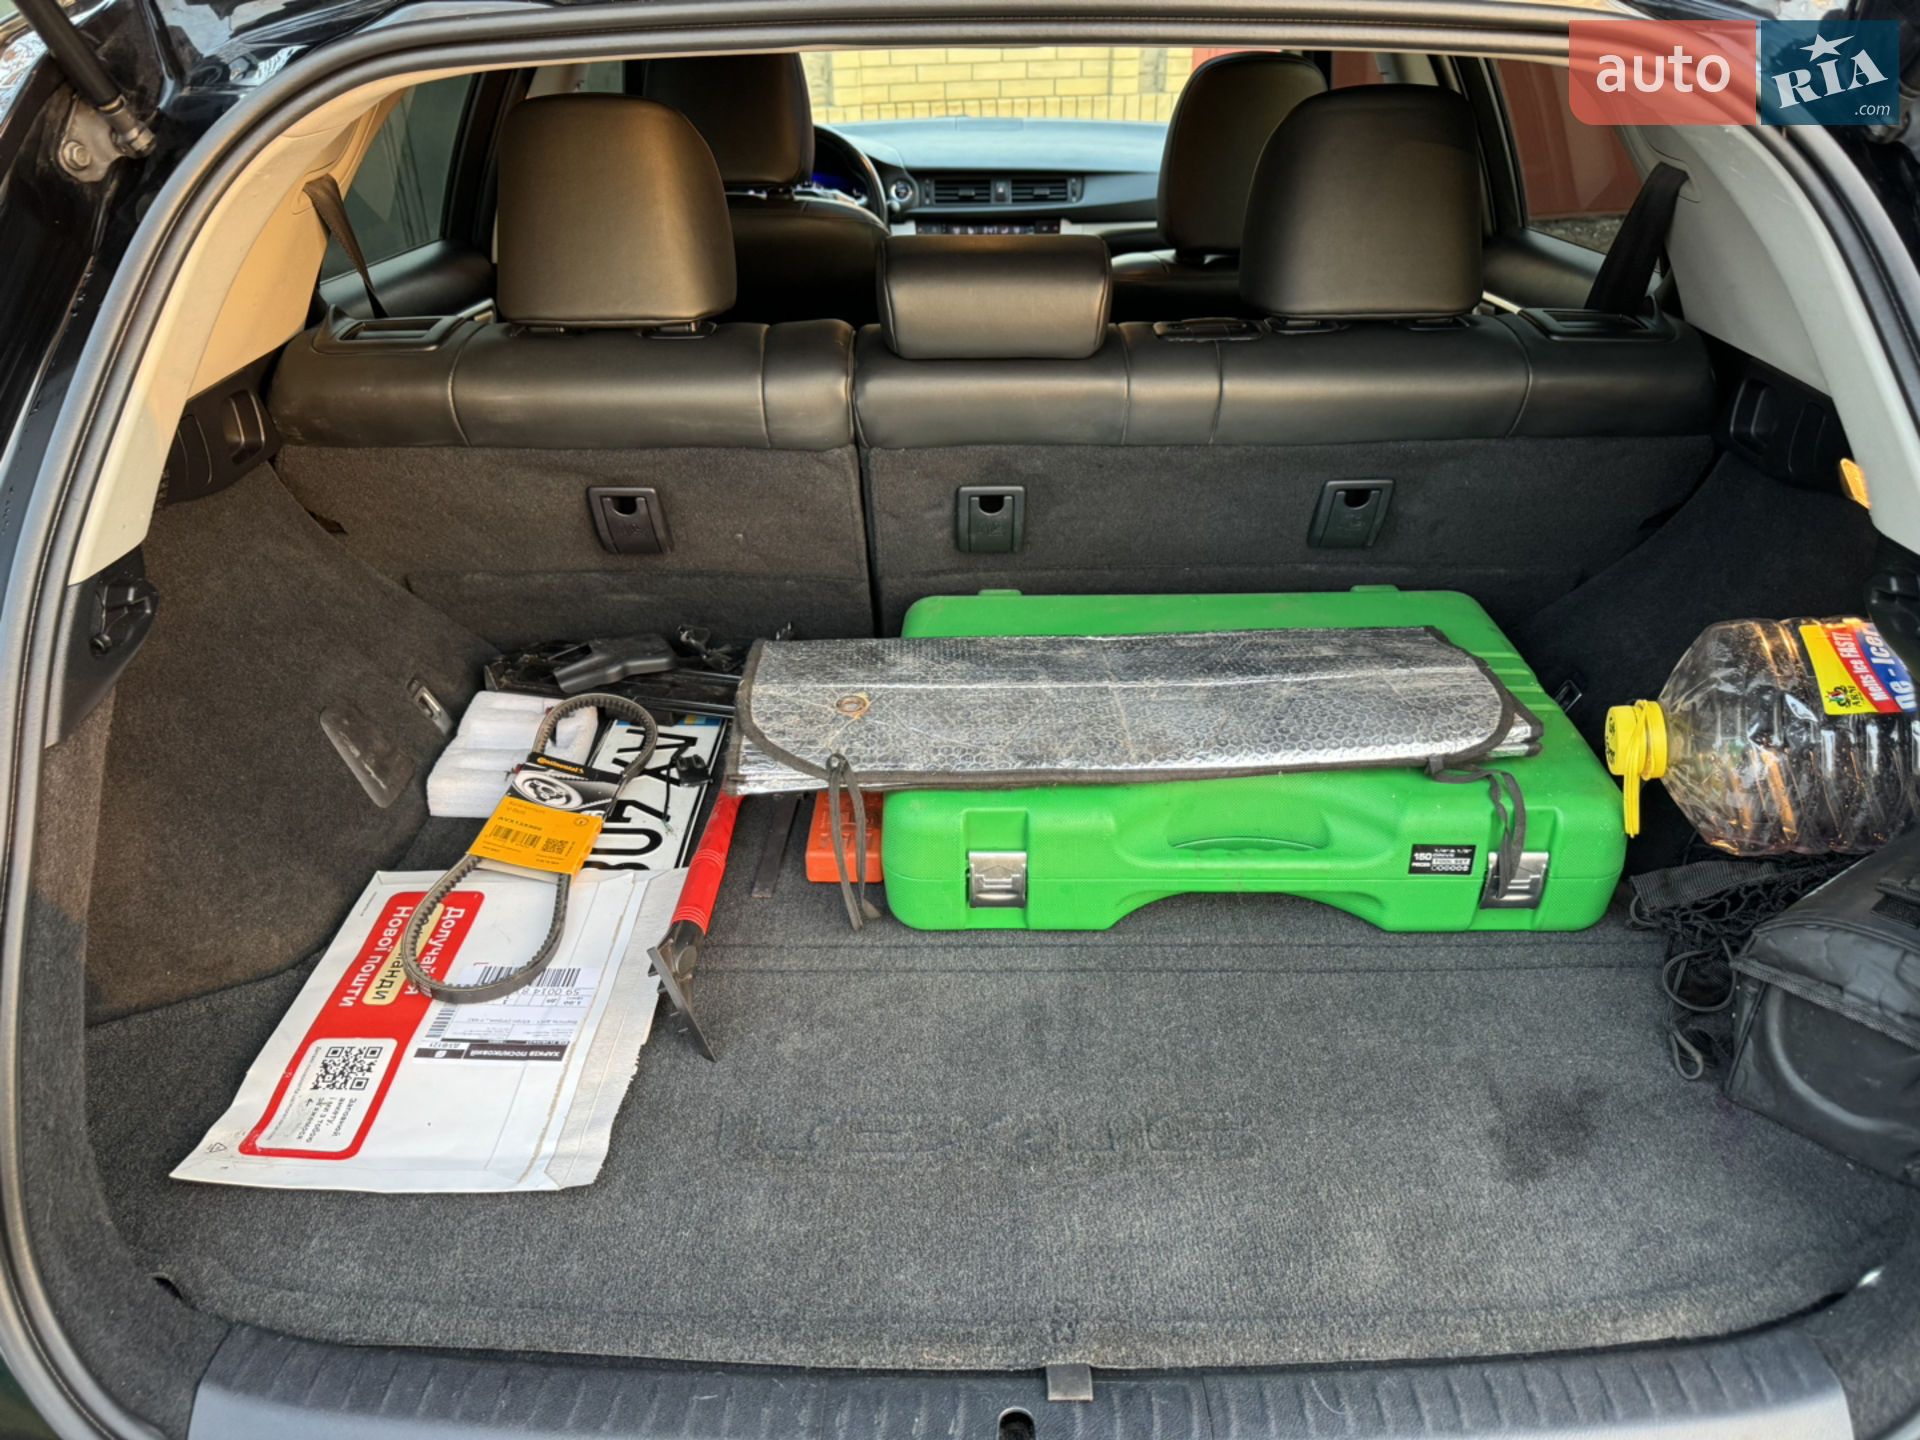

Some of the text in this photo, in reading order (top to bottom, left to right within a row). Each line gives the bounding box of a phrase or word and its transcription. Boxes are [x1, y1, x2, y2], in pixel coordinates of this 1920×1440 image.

[1831, 631, 1890, 701] Melts Ice FAST!
[536, 756, 581, 773] Continental
[1413, 852, 1433, 861] 150
[338, 905, 413, 1008] Нової пошти
[404, 906, 465, 995] Долучайя
